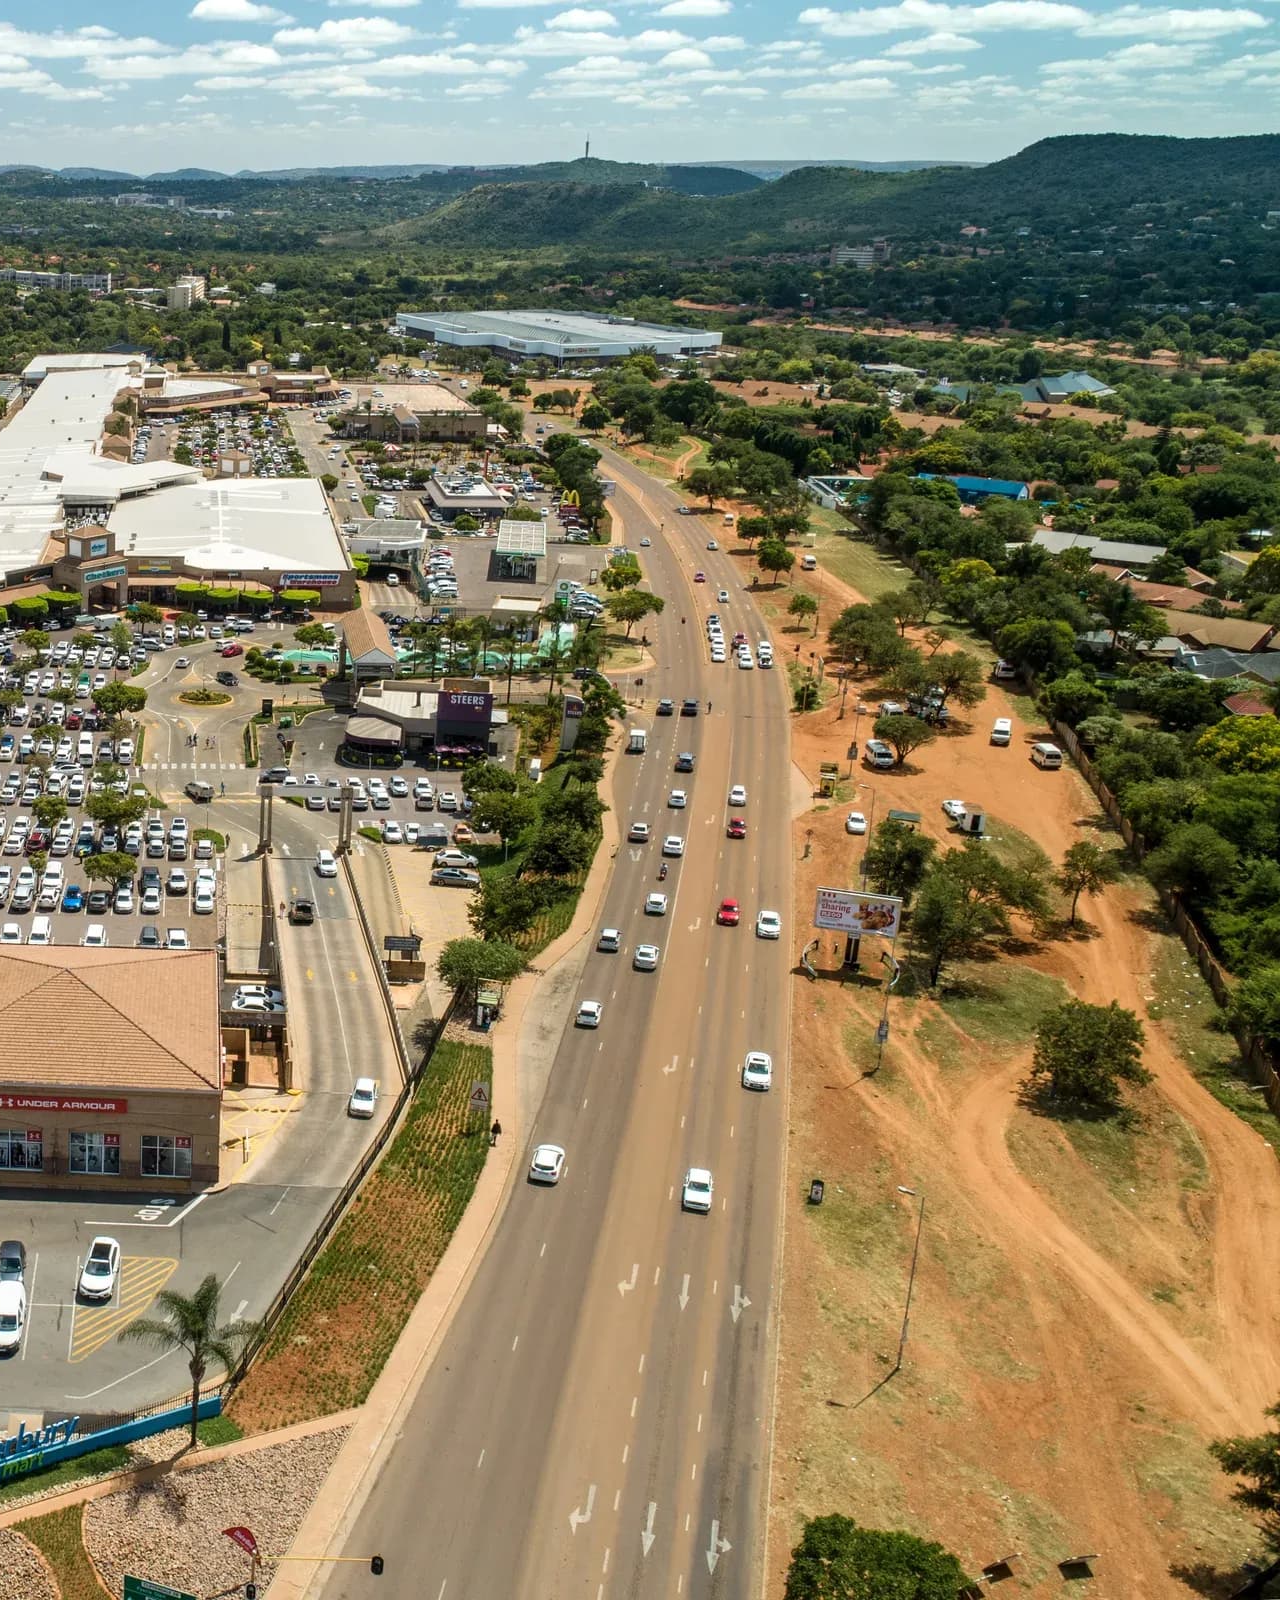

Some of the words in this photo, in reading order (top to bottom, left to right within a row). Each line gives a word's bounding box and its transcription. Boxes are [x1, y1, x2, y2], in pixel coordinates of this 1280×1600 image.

[450, 694, 485, 705] STEERS
[821, 902, 852, 914] sharing
[17, 1099, 59, 1108] UNDER
[62, 1101, 116, 1110] ARMOUR
[134, 1198, 176, 1221] STOP
[3, 1450, 45, 1477] mart
